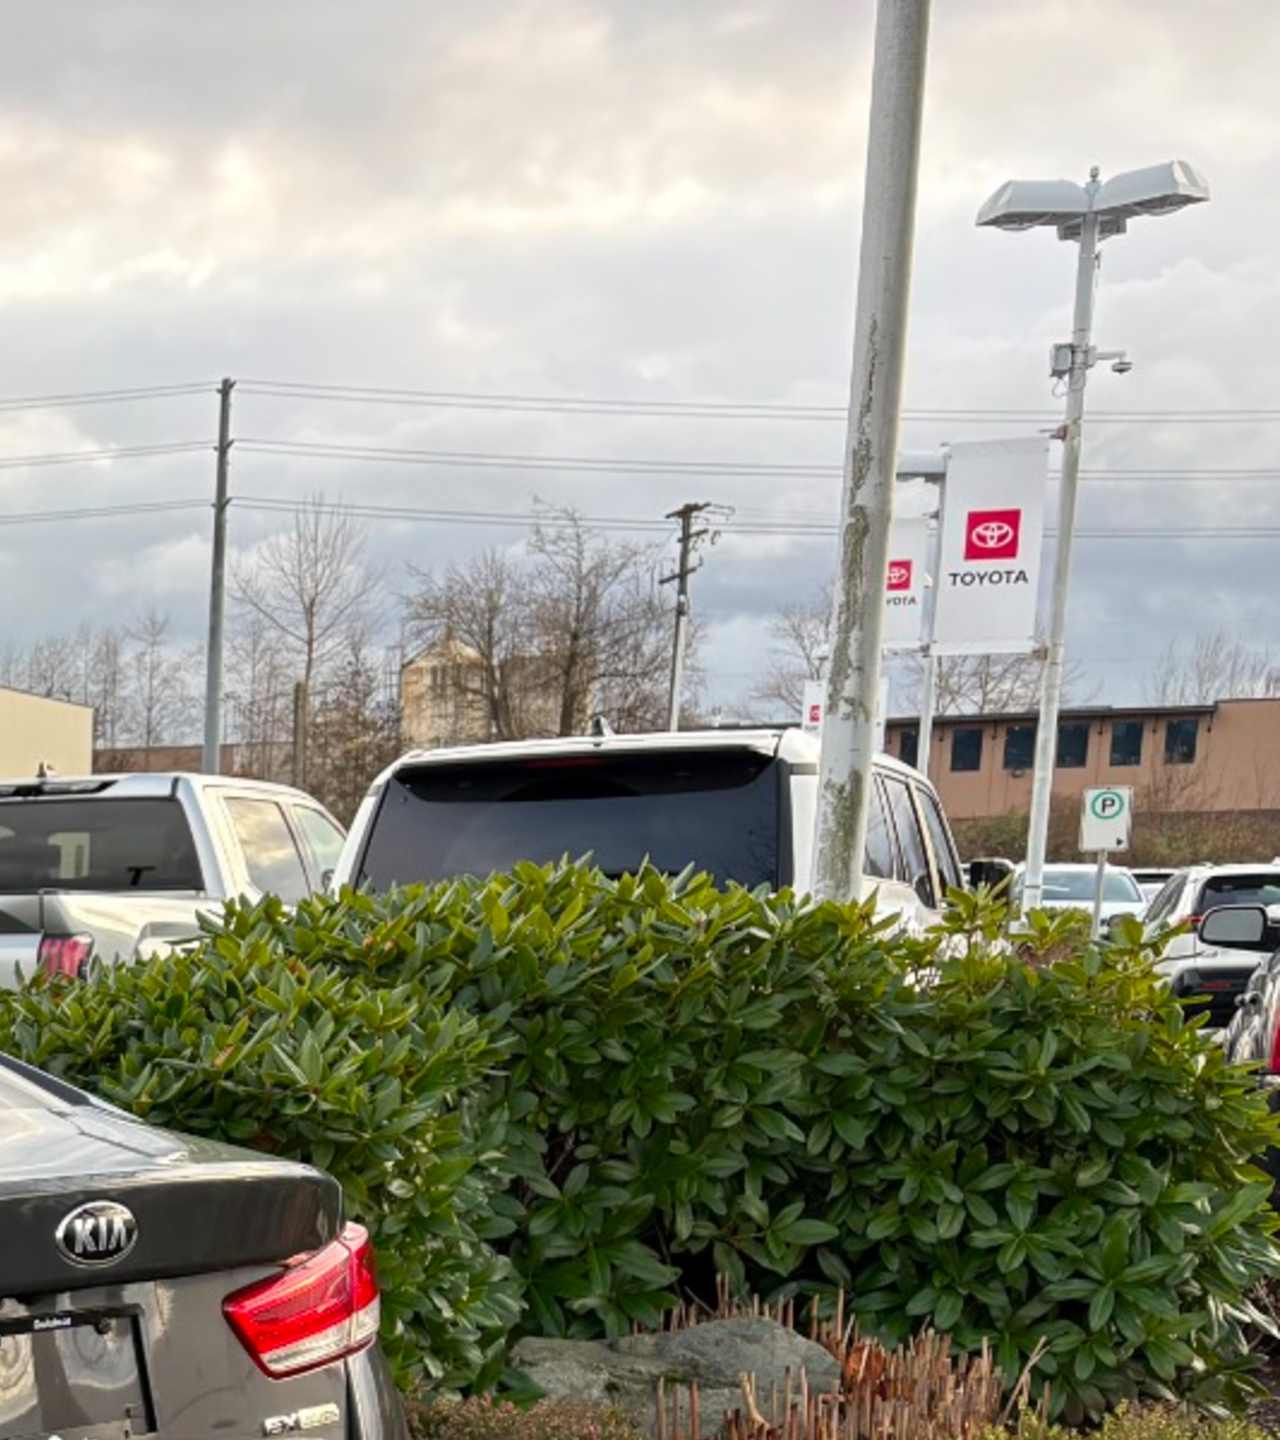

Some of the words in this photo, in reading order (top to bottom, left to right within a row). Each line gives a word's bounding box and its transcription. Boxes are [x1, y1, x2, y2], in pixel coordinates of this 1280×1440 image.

[948, 570, 1028, 587] TOYOTA
[1101, 796, 1116, 814] P
[72, 1214, 127, 1254] KIA
